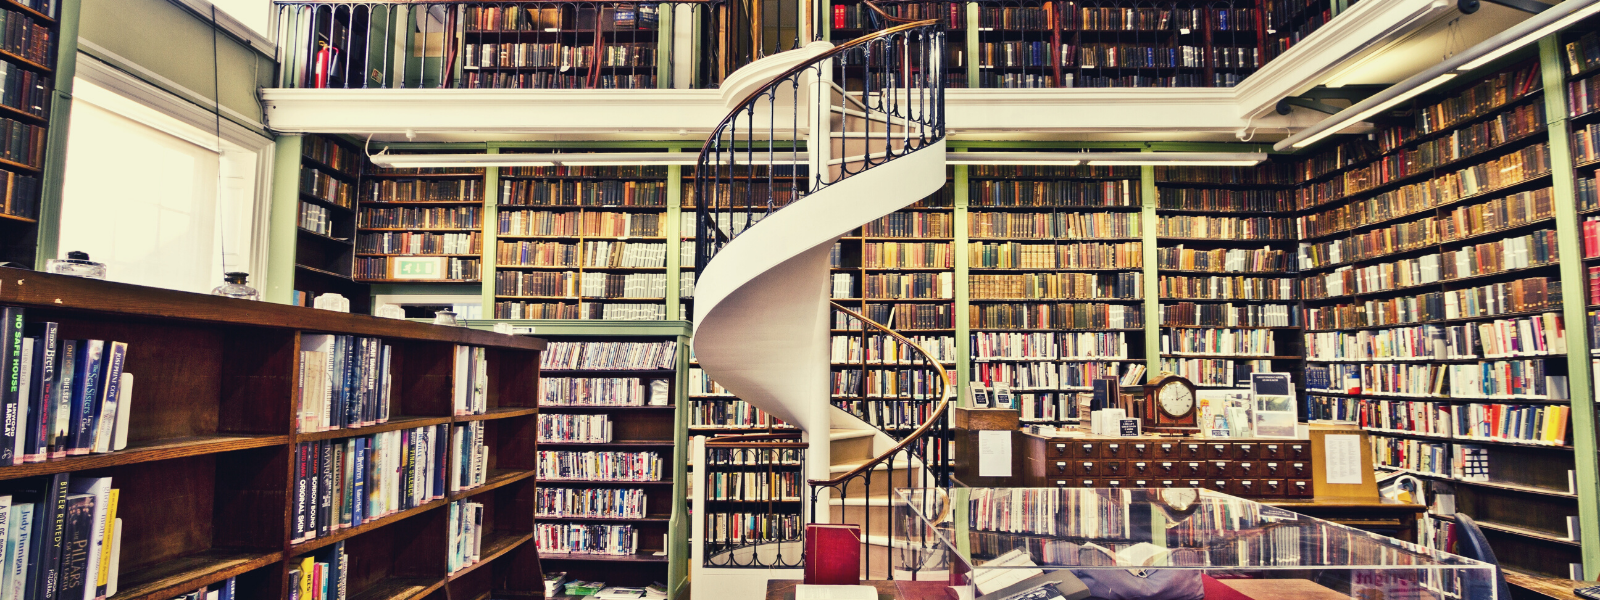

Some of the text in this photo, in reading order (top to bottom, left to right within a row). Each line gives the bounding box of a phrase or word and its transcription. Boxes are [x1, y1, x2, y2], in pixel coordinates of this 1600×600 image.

[11, 314, 22, 392] NO SAFE HOUSE
[45, 350, 55, 373] Brett
[109, 352, 122, 398] JOSEPHINE COX
[62, 377, 70, 403] CHELSEA
[84, 388, 95, 414] Sisters
[86, 373, 97, 388] Sea
[54, 481, 67, 548] BITTER REMEDY
[16, 511, 30, 576] Judy Finnigan
[69, 539, 88, 588] PILLARS
